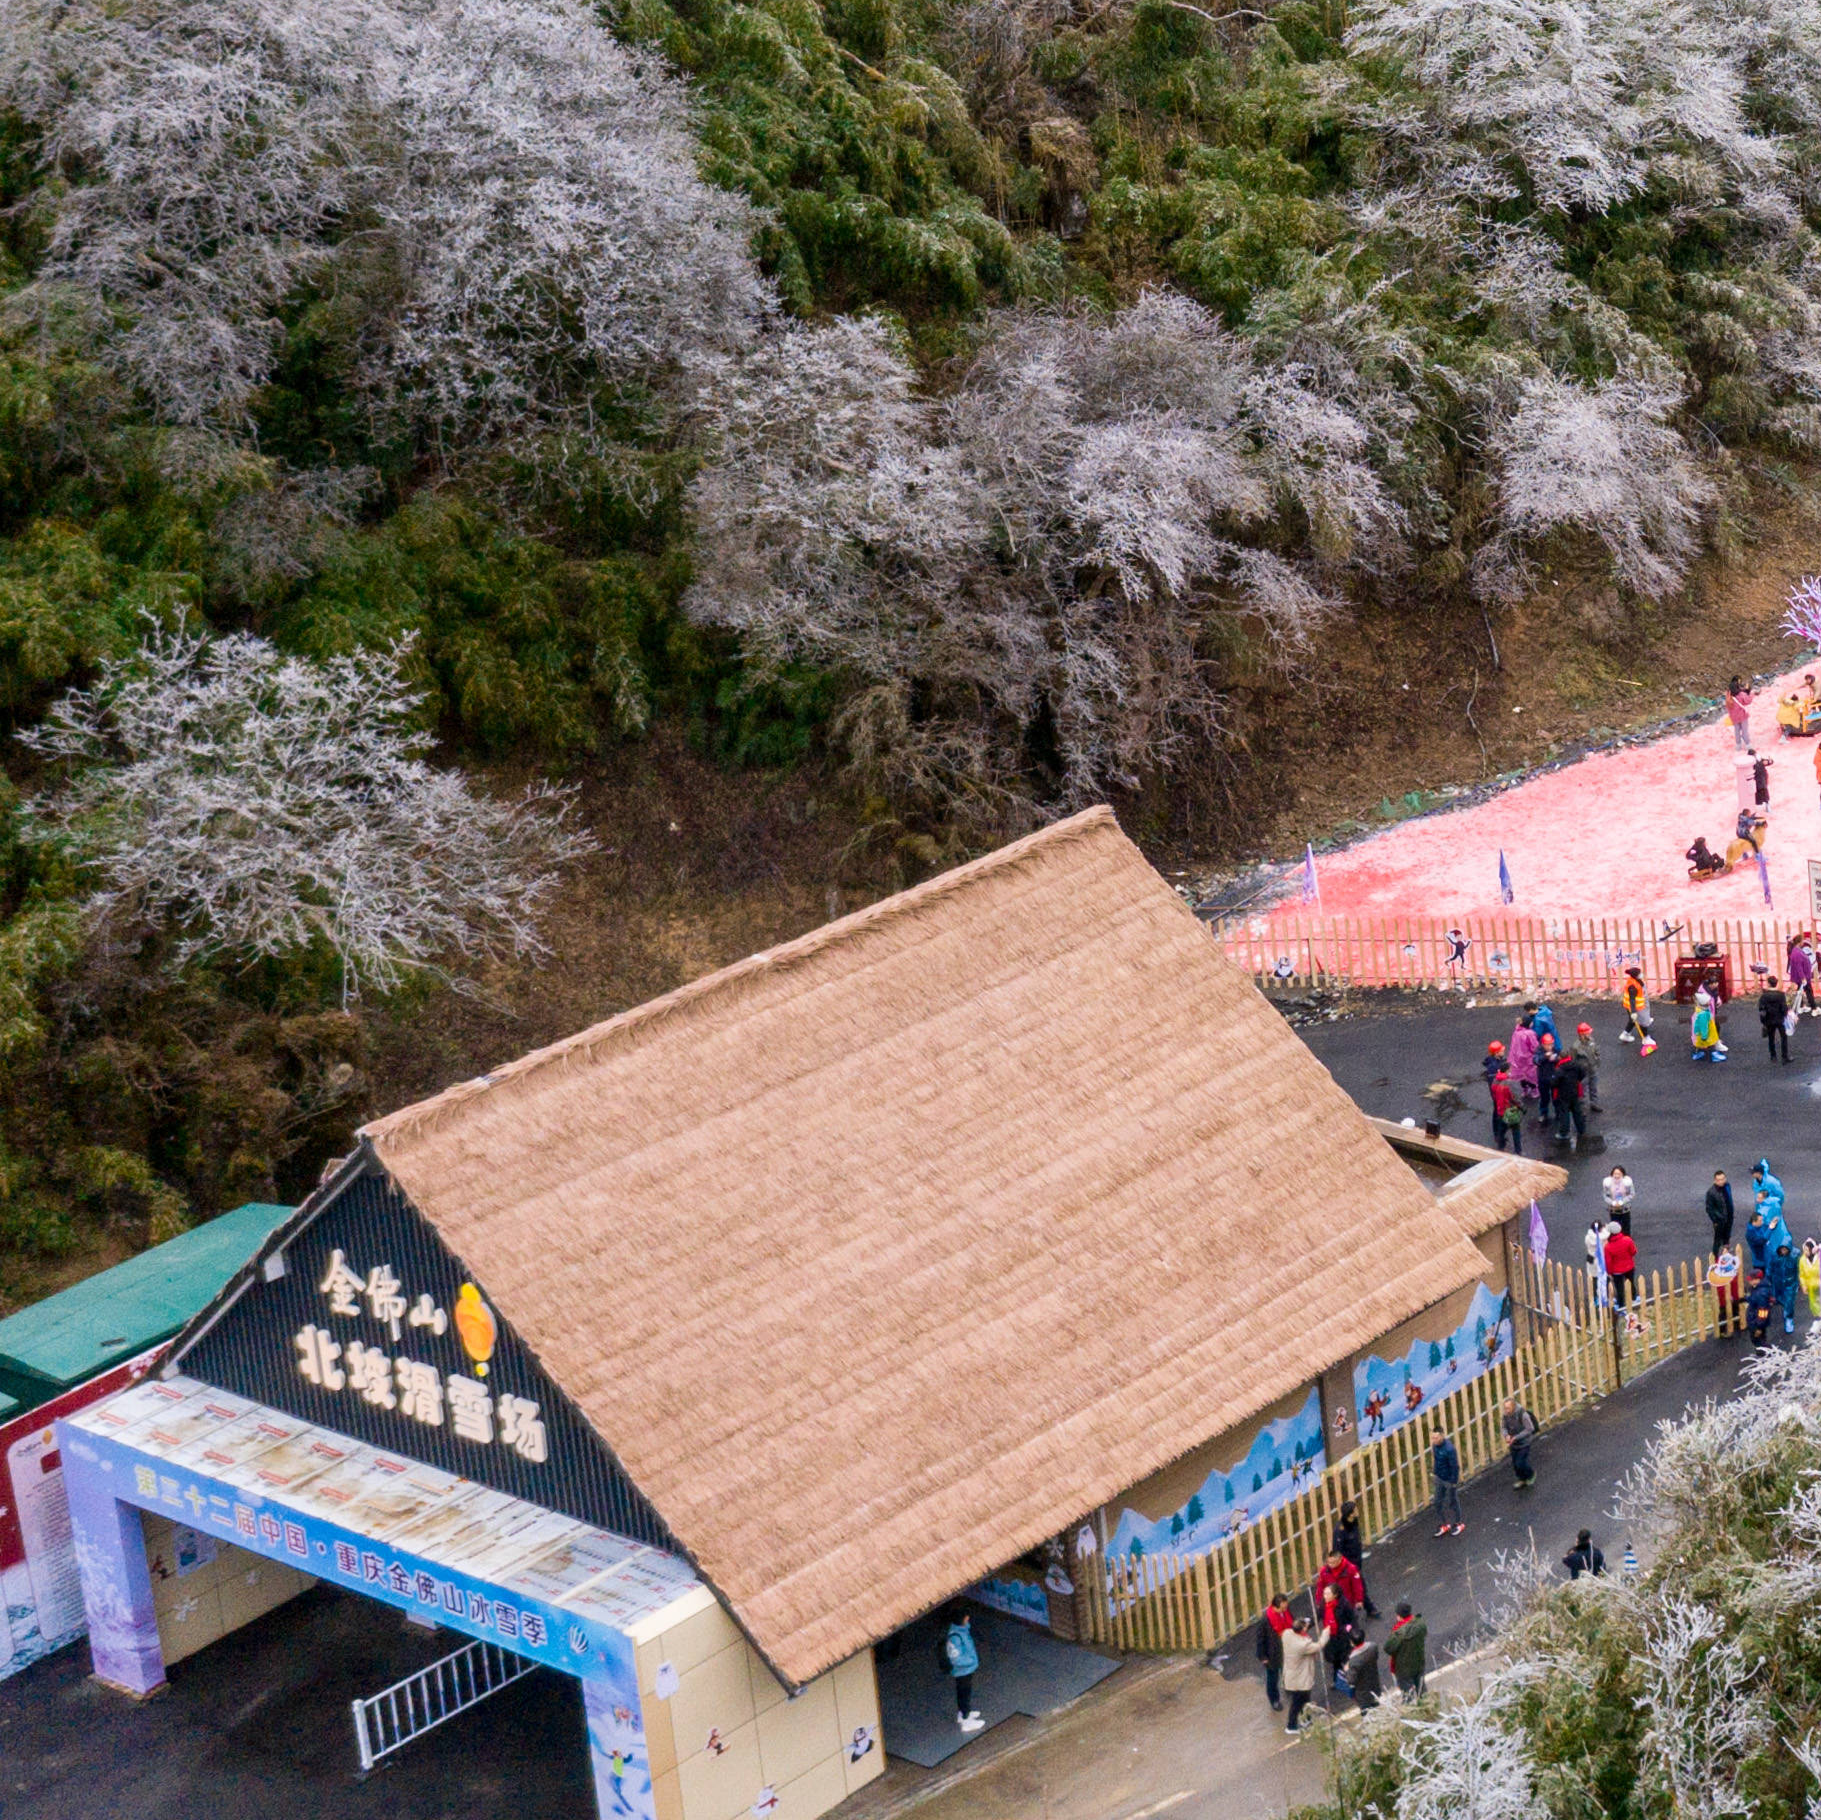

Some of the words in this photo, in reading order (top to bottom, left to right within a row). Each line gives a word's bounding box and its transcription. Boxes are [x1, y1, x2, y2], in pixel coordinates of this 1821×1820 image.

[319, 1248, 448, 1342] 金佛山
[295, 1323, 548, 1463] 北坡滑雪场
[133, 1465, 549, 1647] 第二十二届中国·重庆金佛山冰雪季
